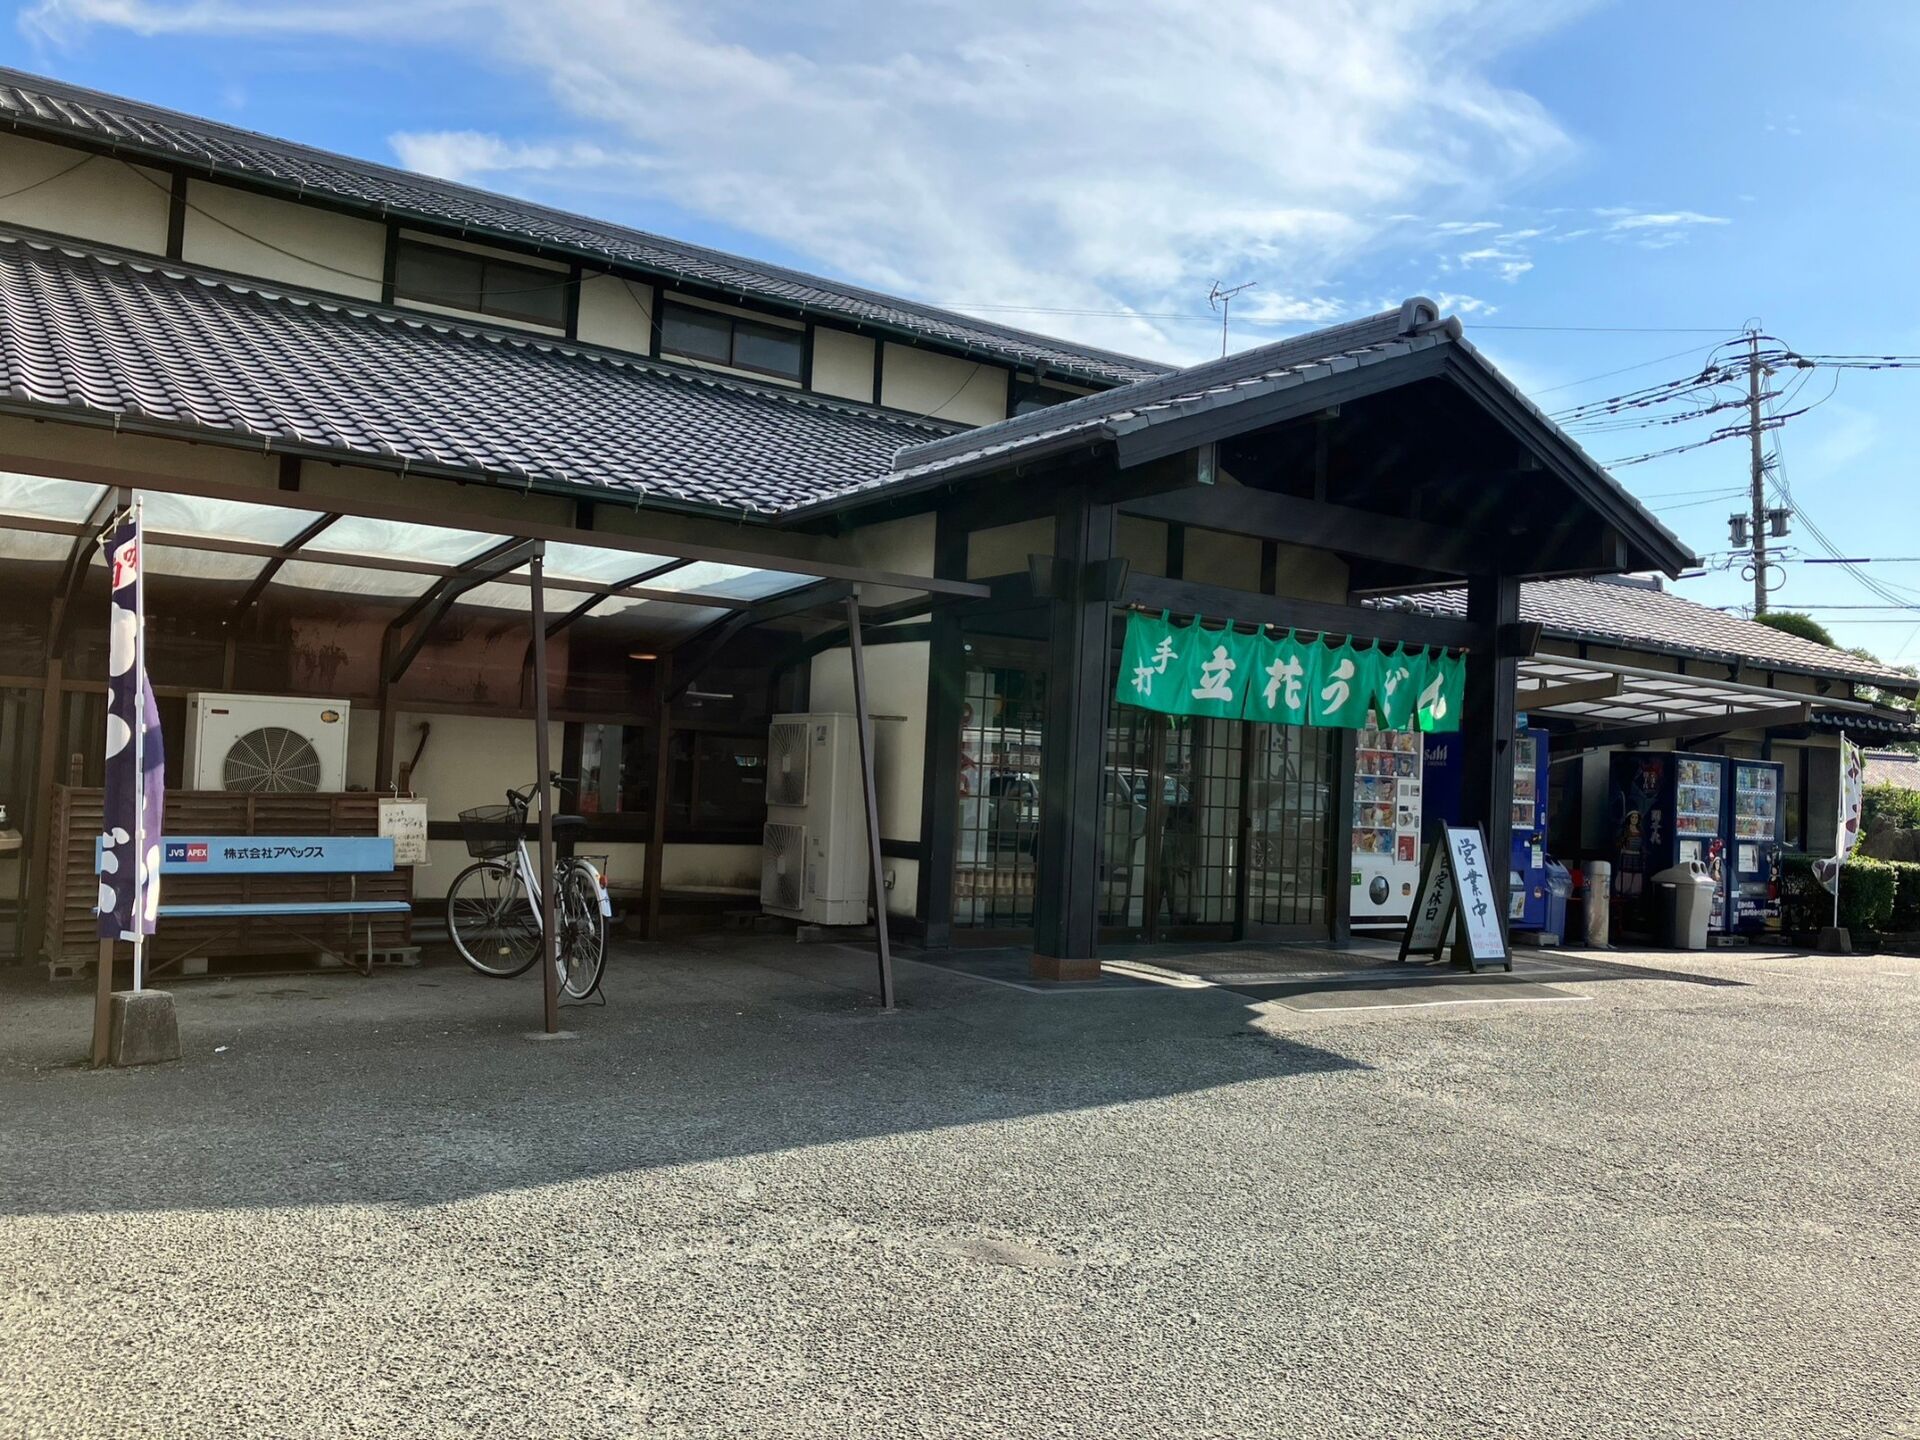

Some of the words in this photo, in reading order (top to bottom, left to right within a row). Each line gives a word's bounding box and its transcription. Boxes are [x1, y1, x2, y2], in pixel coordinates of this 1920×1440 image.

[1191, 645, 1448, 720] 立花うどん
[1423, 744, 1448, 760] sahi
[168, 849, 185, 857] JVS
[187, 849, 208, 857] APEX
[223, 846, 325, 860] 株式会社アペックス
[1458, 837, 1488, 929] 営業中
